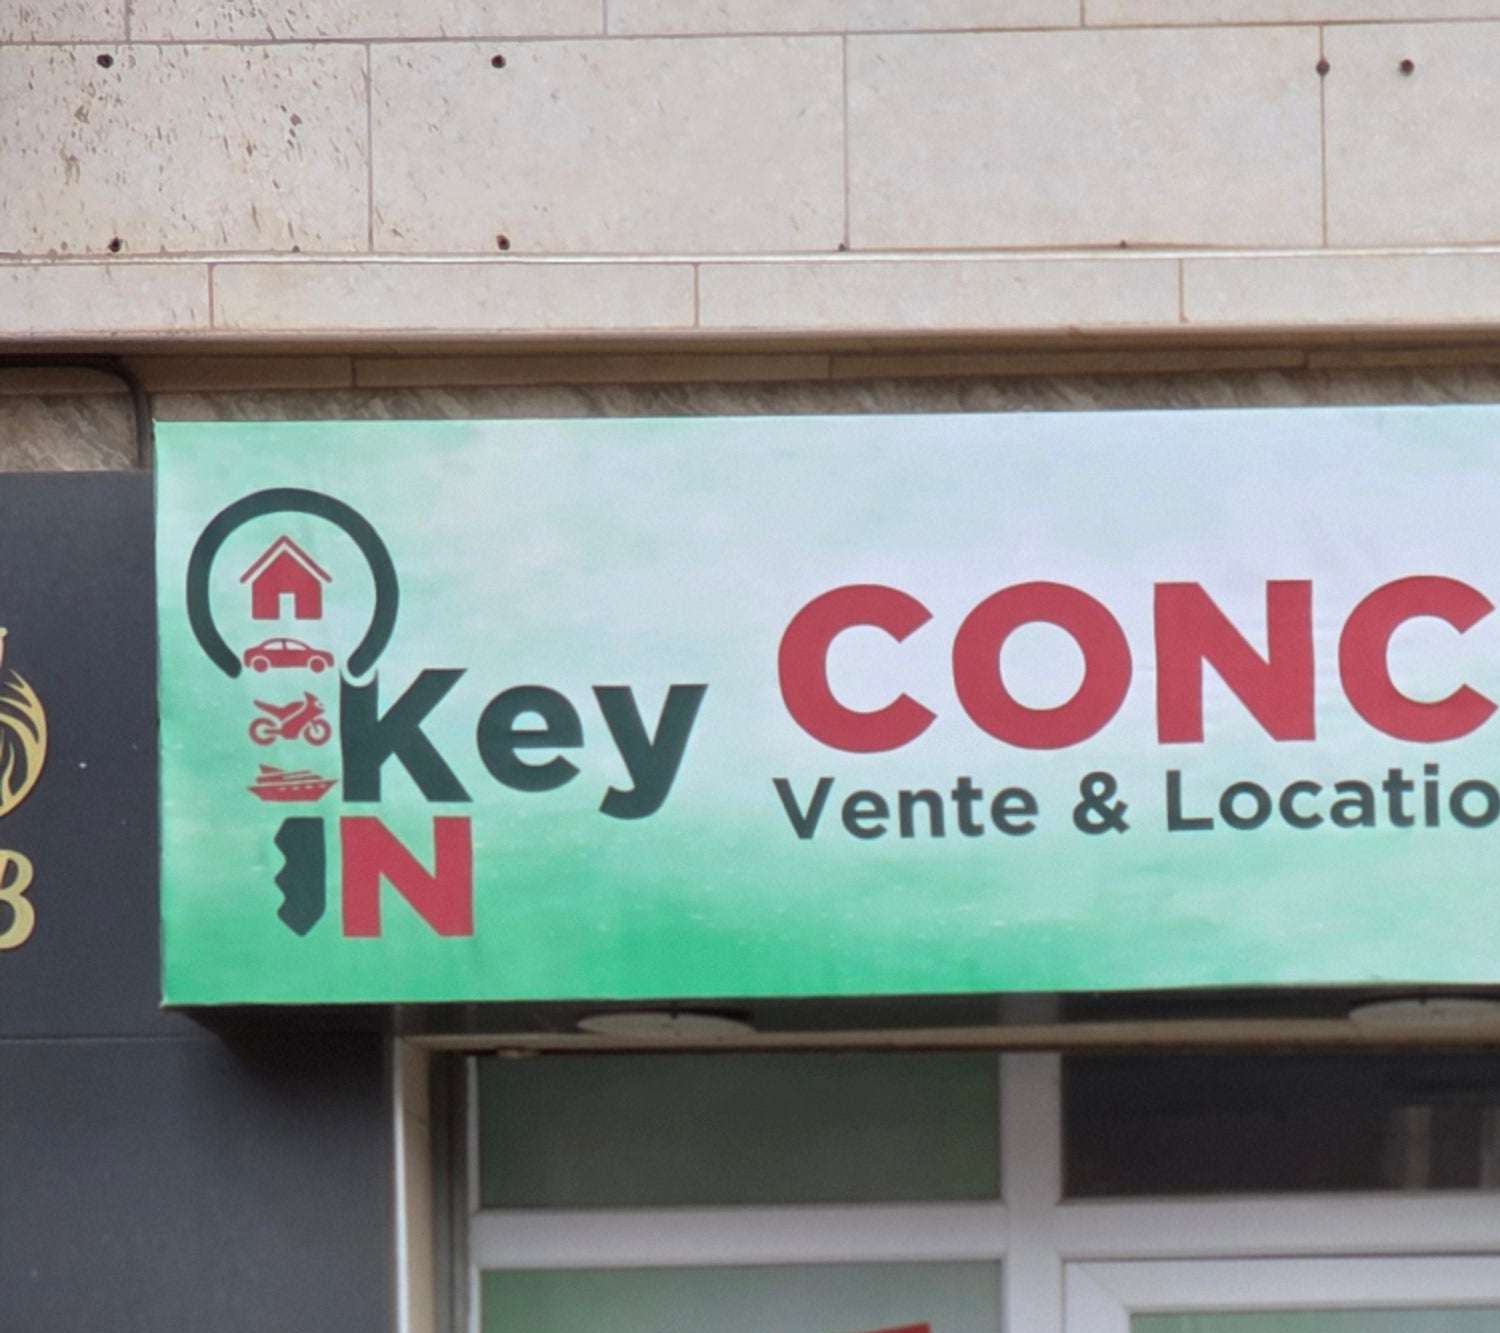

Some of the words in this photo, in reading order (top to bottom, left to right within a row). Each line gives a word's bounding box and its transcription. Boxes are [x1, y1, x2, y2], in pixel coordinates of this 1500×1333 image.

[340, 667, 708, 820] Key
[772, 775, 1039, 840] Vente
[1072, 771, 1130, 834] &
